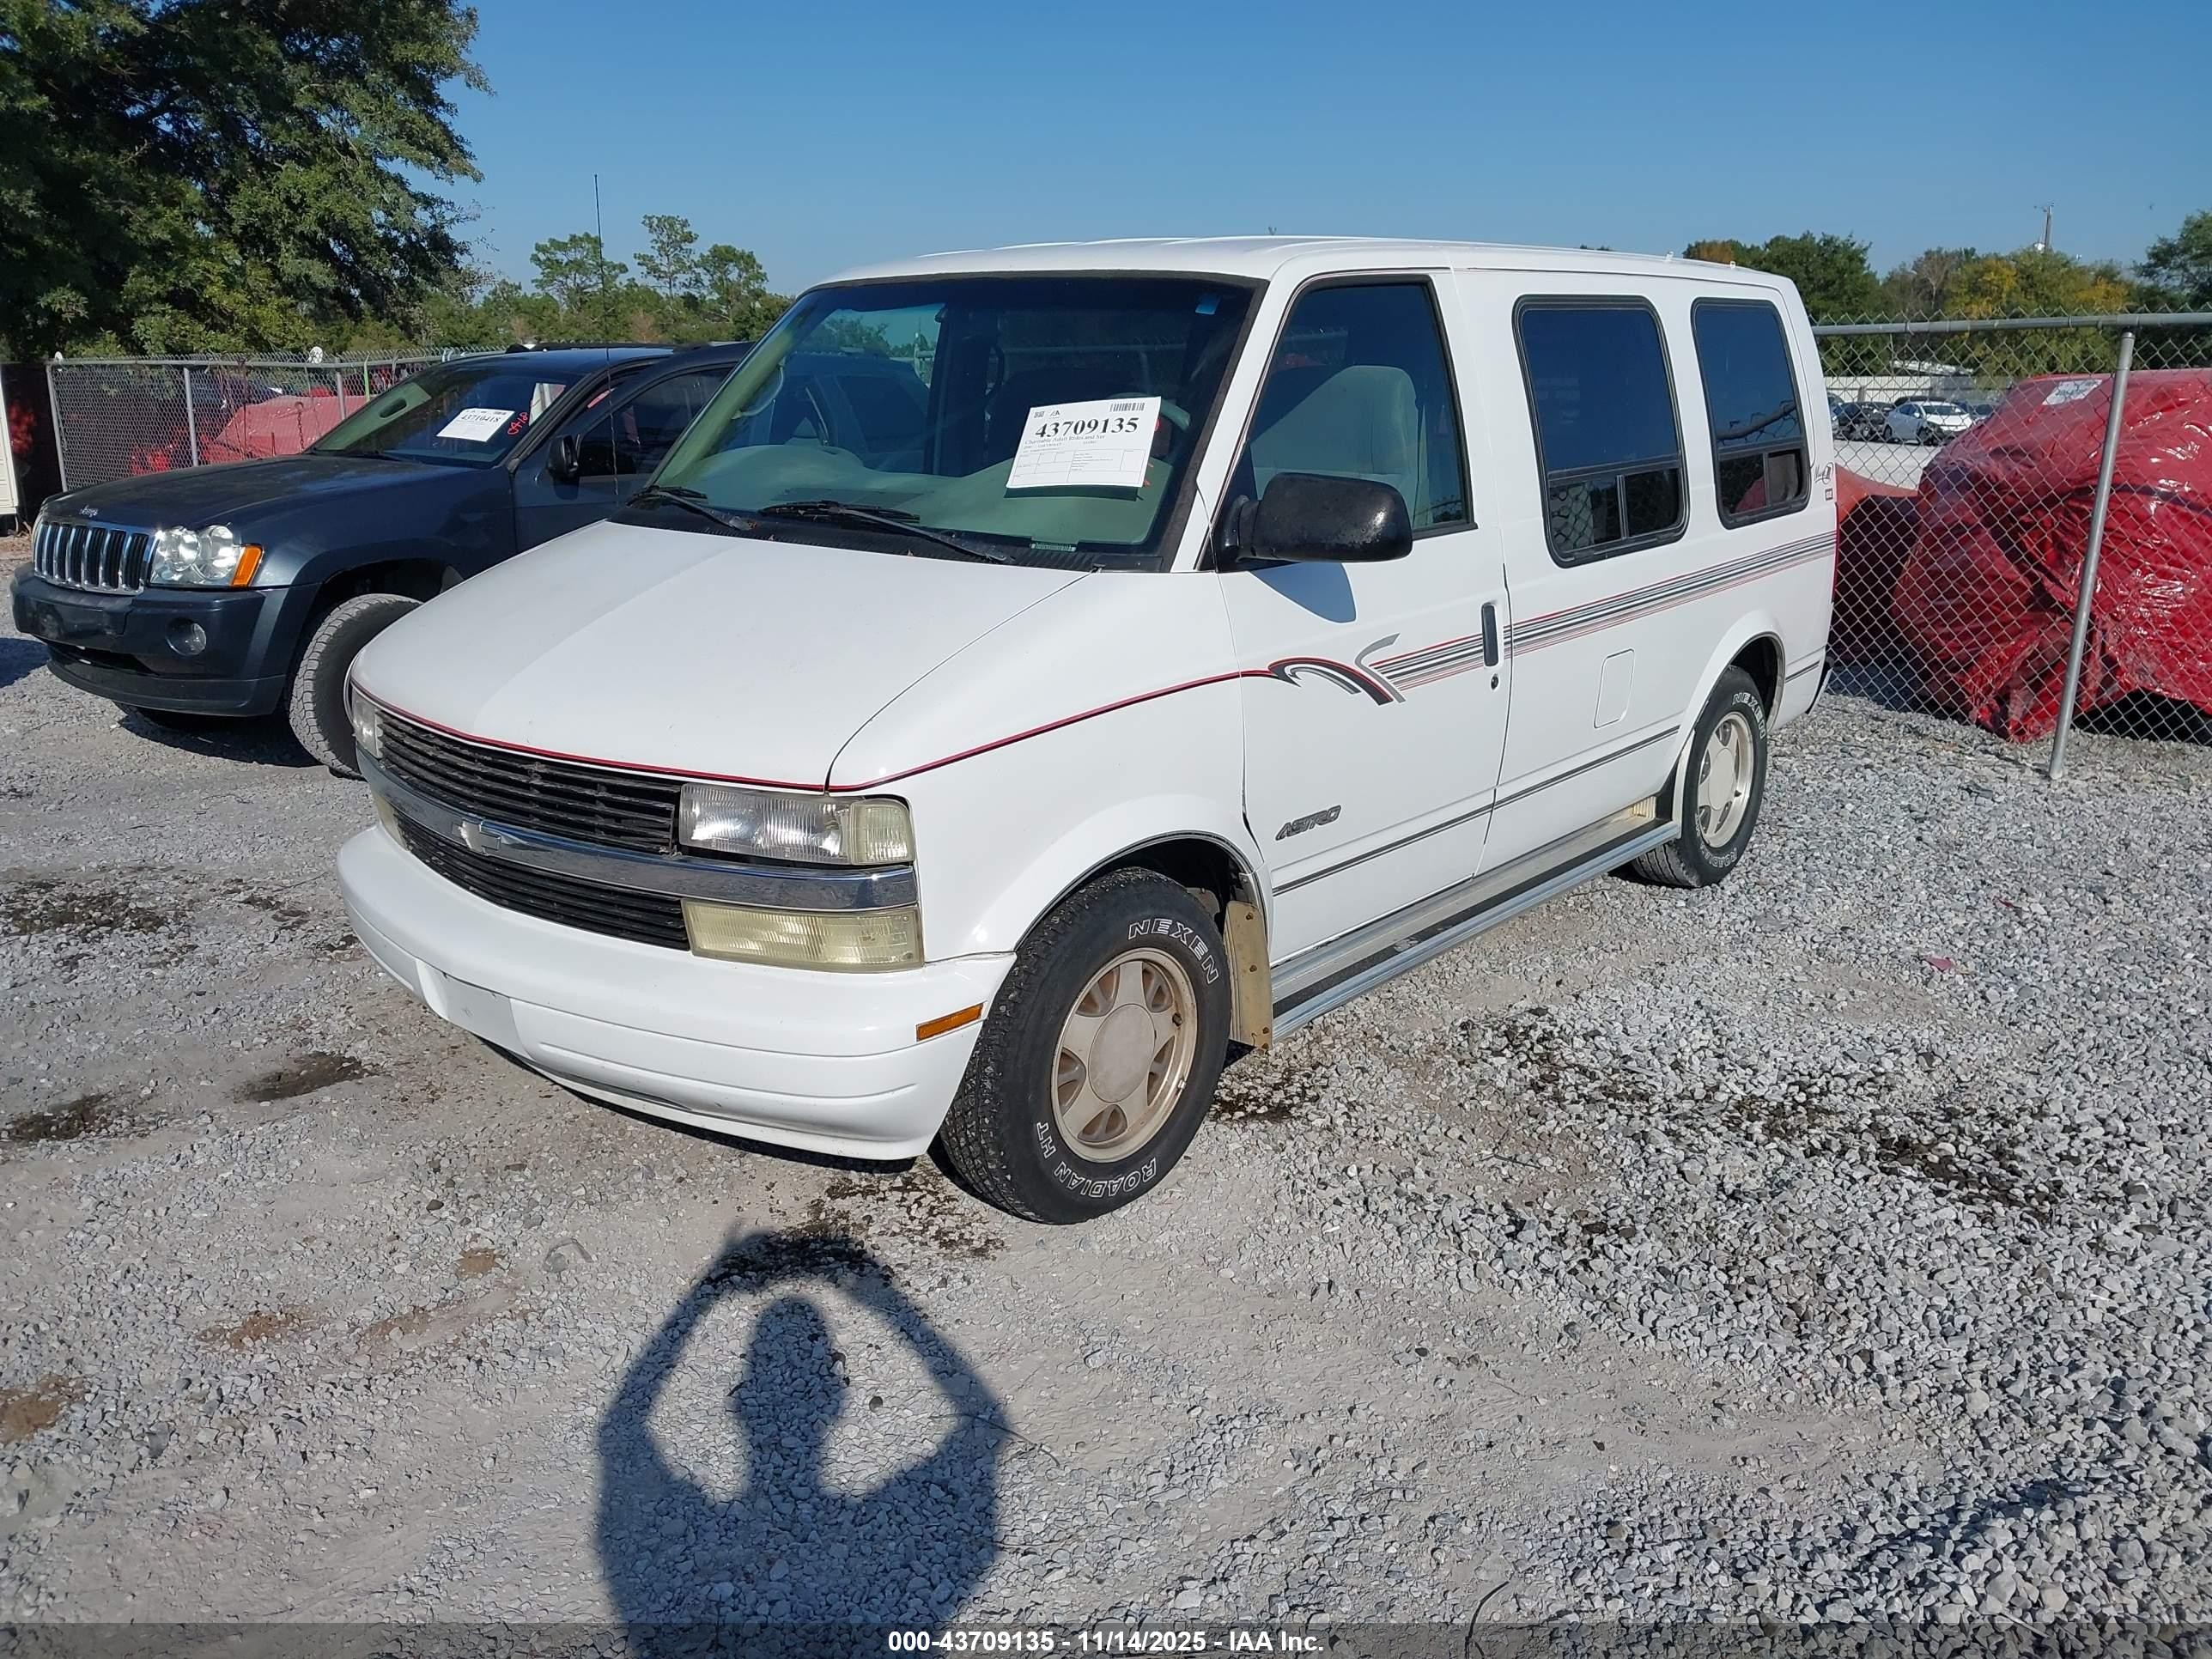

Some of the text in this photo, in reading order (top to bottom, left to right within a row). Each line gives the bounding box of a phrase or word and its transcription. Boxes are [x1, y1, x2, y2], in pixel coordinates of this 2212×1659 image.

[1025, 437, 1051, 446] Charitable
[1035, 417, 1140, 438] 43709135
[1731, 691, 1766, 740] NEXEN
[1275, 805, 1341, 841] ASTRO
[1127, 917, 1220, 985] NEXEN
[1036, 1121, 1158, 1199] ROADIAN HT
